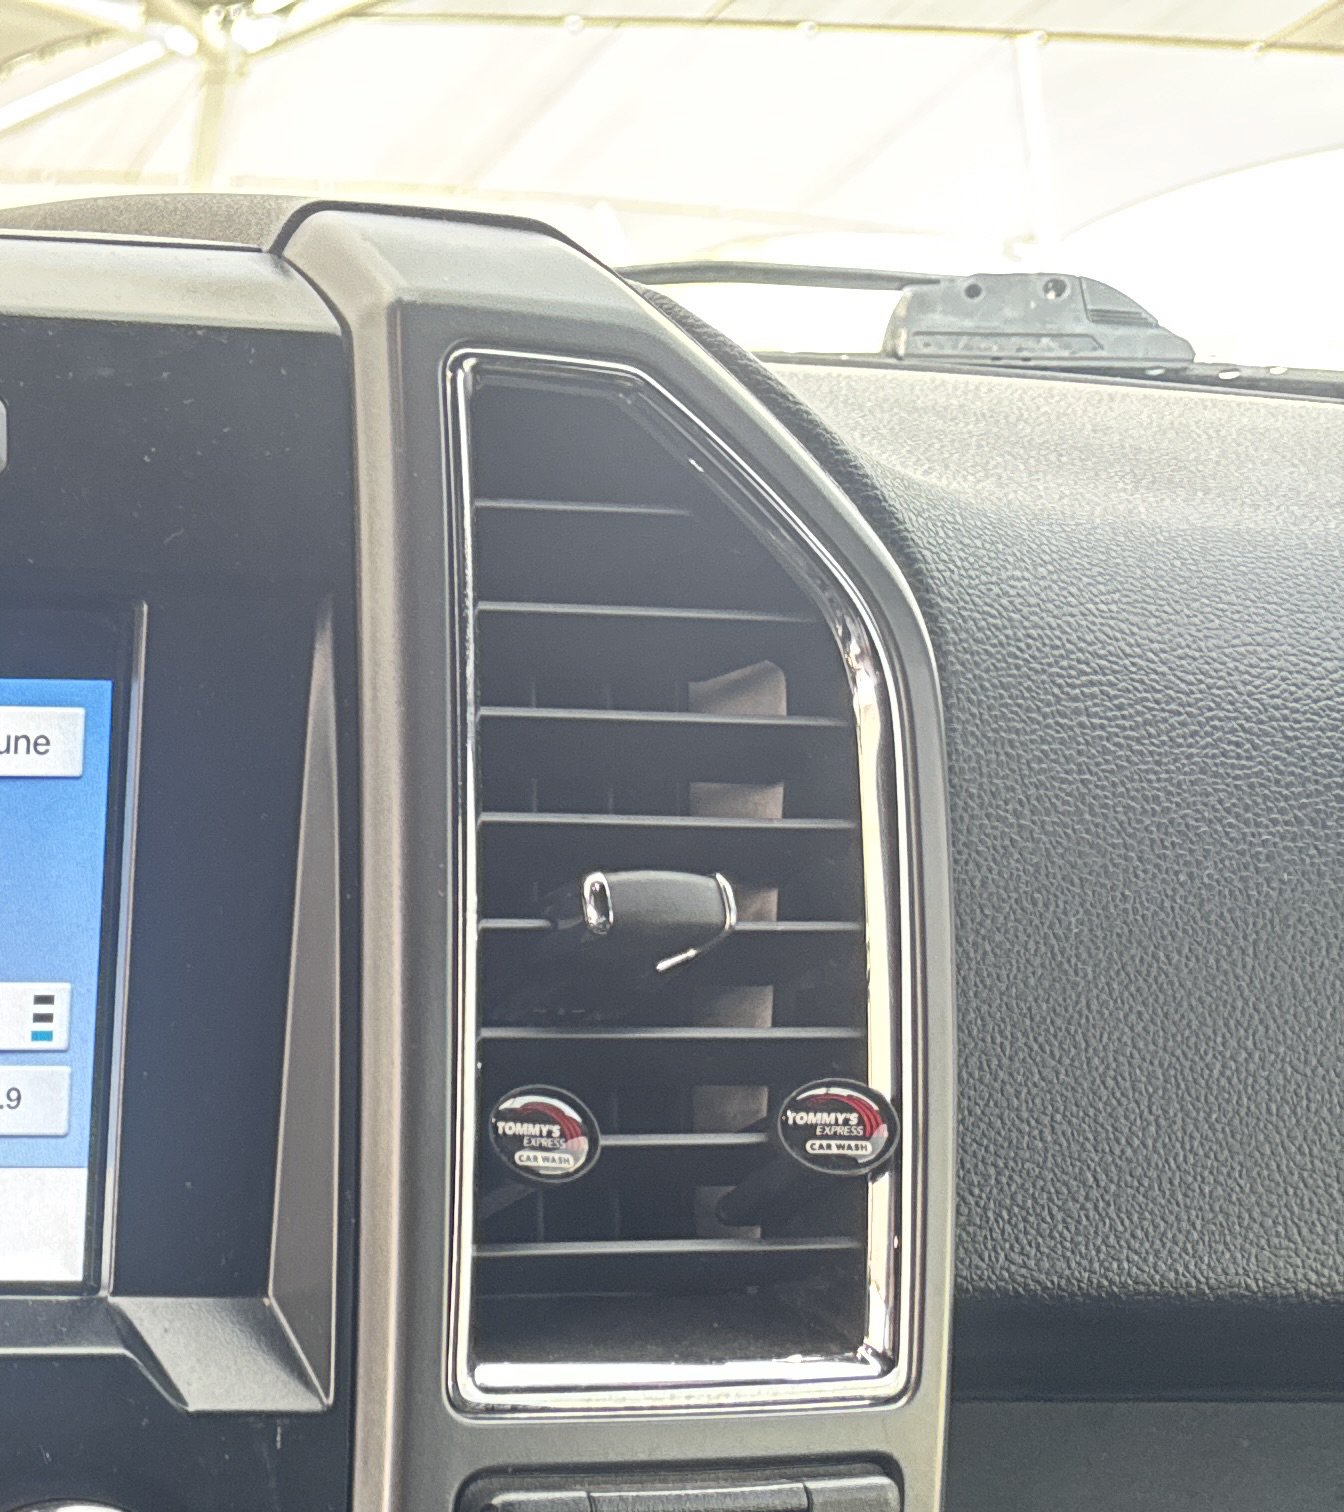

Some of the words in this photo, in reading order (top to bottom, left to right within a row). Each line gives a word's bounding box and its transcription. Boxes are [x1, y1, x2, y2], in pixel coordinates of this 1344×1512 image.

[786, 1111, 859, 1126] TOMMY'S
[497, 1120, 561, 1138] TOMMY'S
[815, 1124, 864, 1137] EXPRESS
[522, 1136, 566, 1149] EXPRESS
[809, 1142, 833, 1153] CAR
[835, 1142, 869, 1154] WASH
[518, 1153, 538, 1164] CAR
[540, 1154, 571, 1166] WASH
